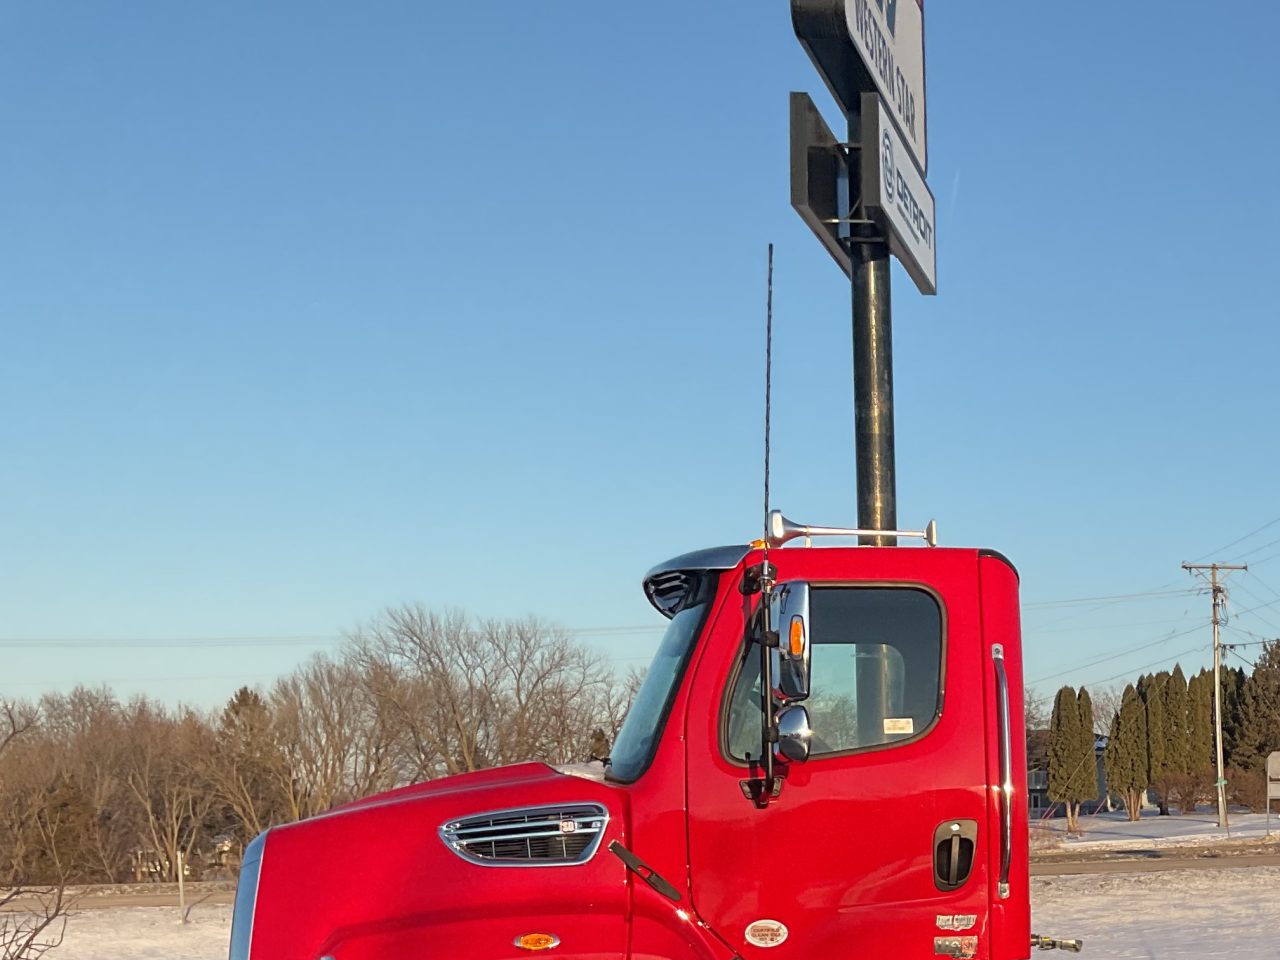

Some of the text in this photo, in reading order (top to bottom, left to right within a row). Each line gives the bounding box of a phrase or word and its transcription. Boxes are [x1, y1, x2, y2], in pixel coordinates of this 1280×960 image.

[855, 0, 917, 144] WESTERN STAR
[896, 168, 932, 249] DETROIT
